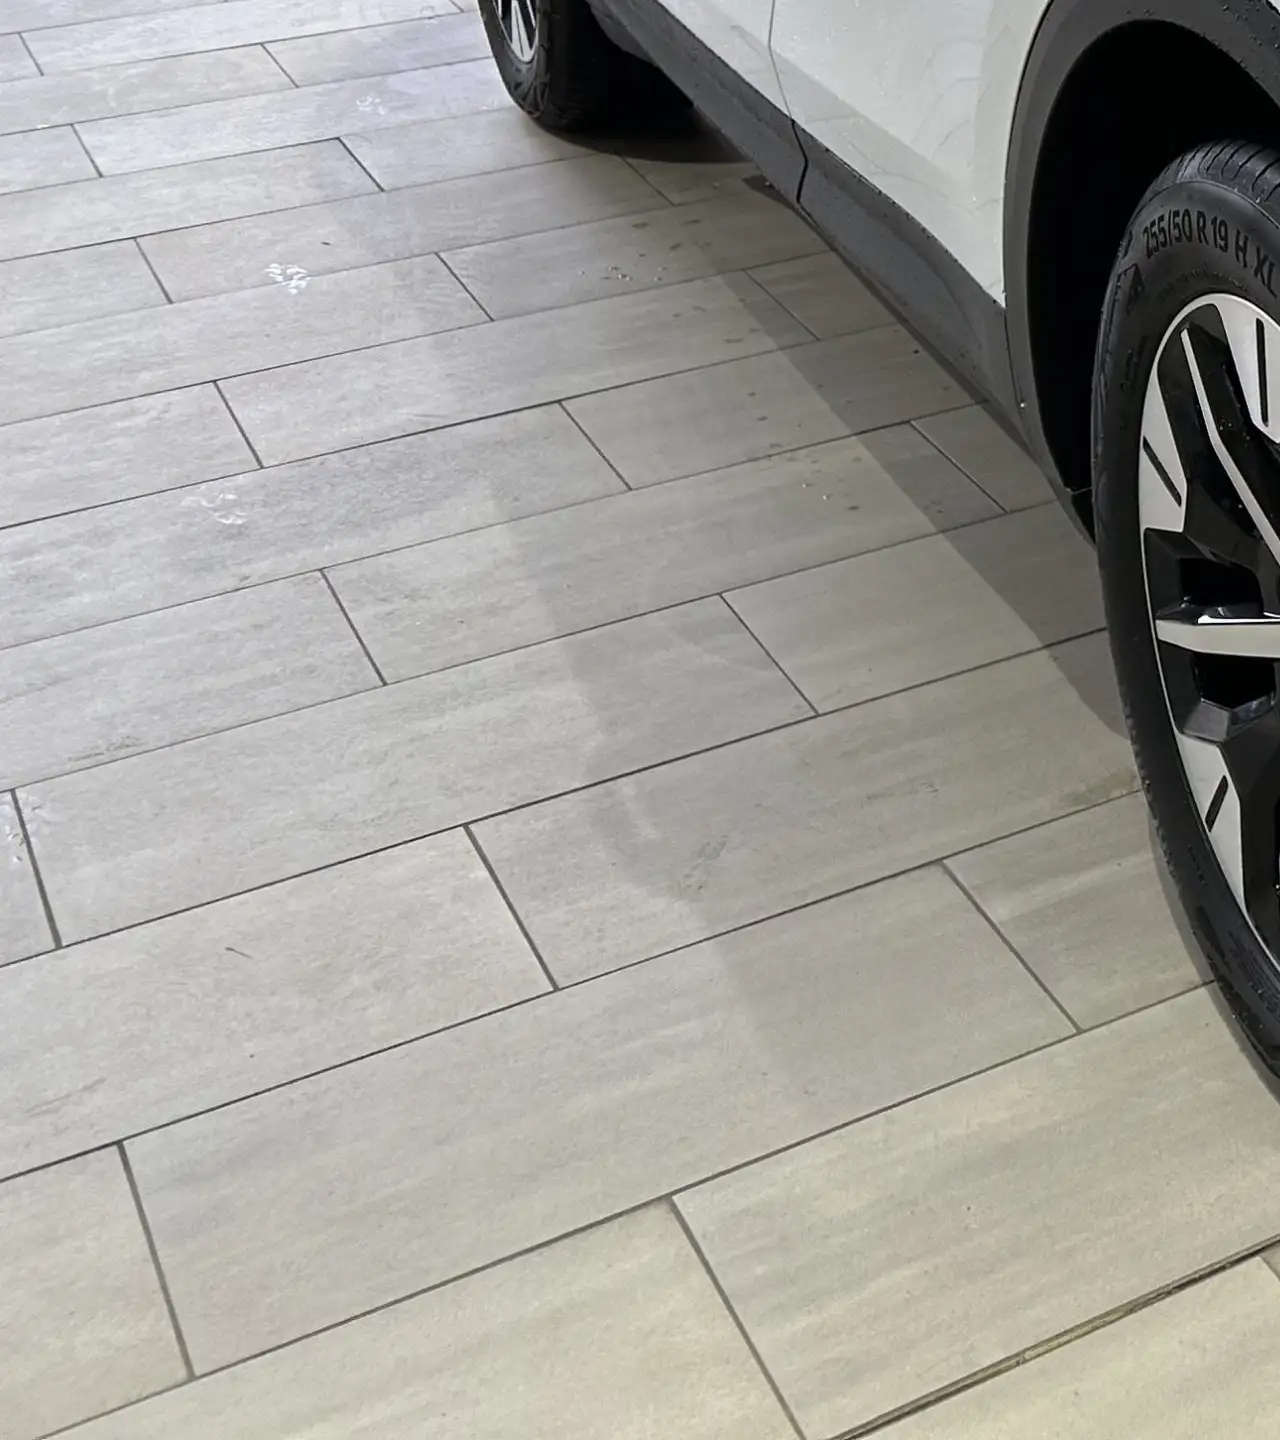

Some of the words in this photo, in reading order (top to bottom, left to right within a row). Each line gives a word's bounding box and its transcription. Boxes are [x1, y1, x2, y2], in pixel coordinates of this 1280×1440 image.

[1143, 208, 1193, 259] 255/50
[1196, 210, 1210, 246] R
[1211, 215, 1229, 253] 19
[1234, 228, 1249, 268] H
[1253, 246, 1279, 300] XL
